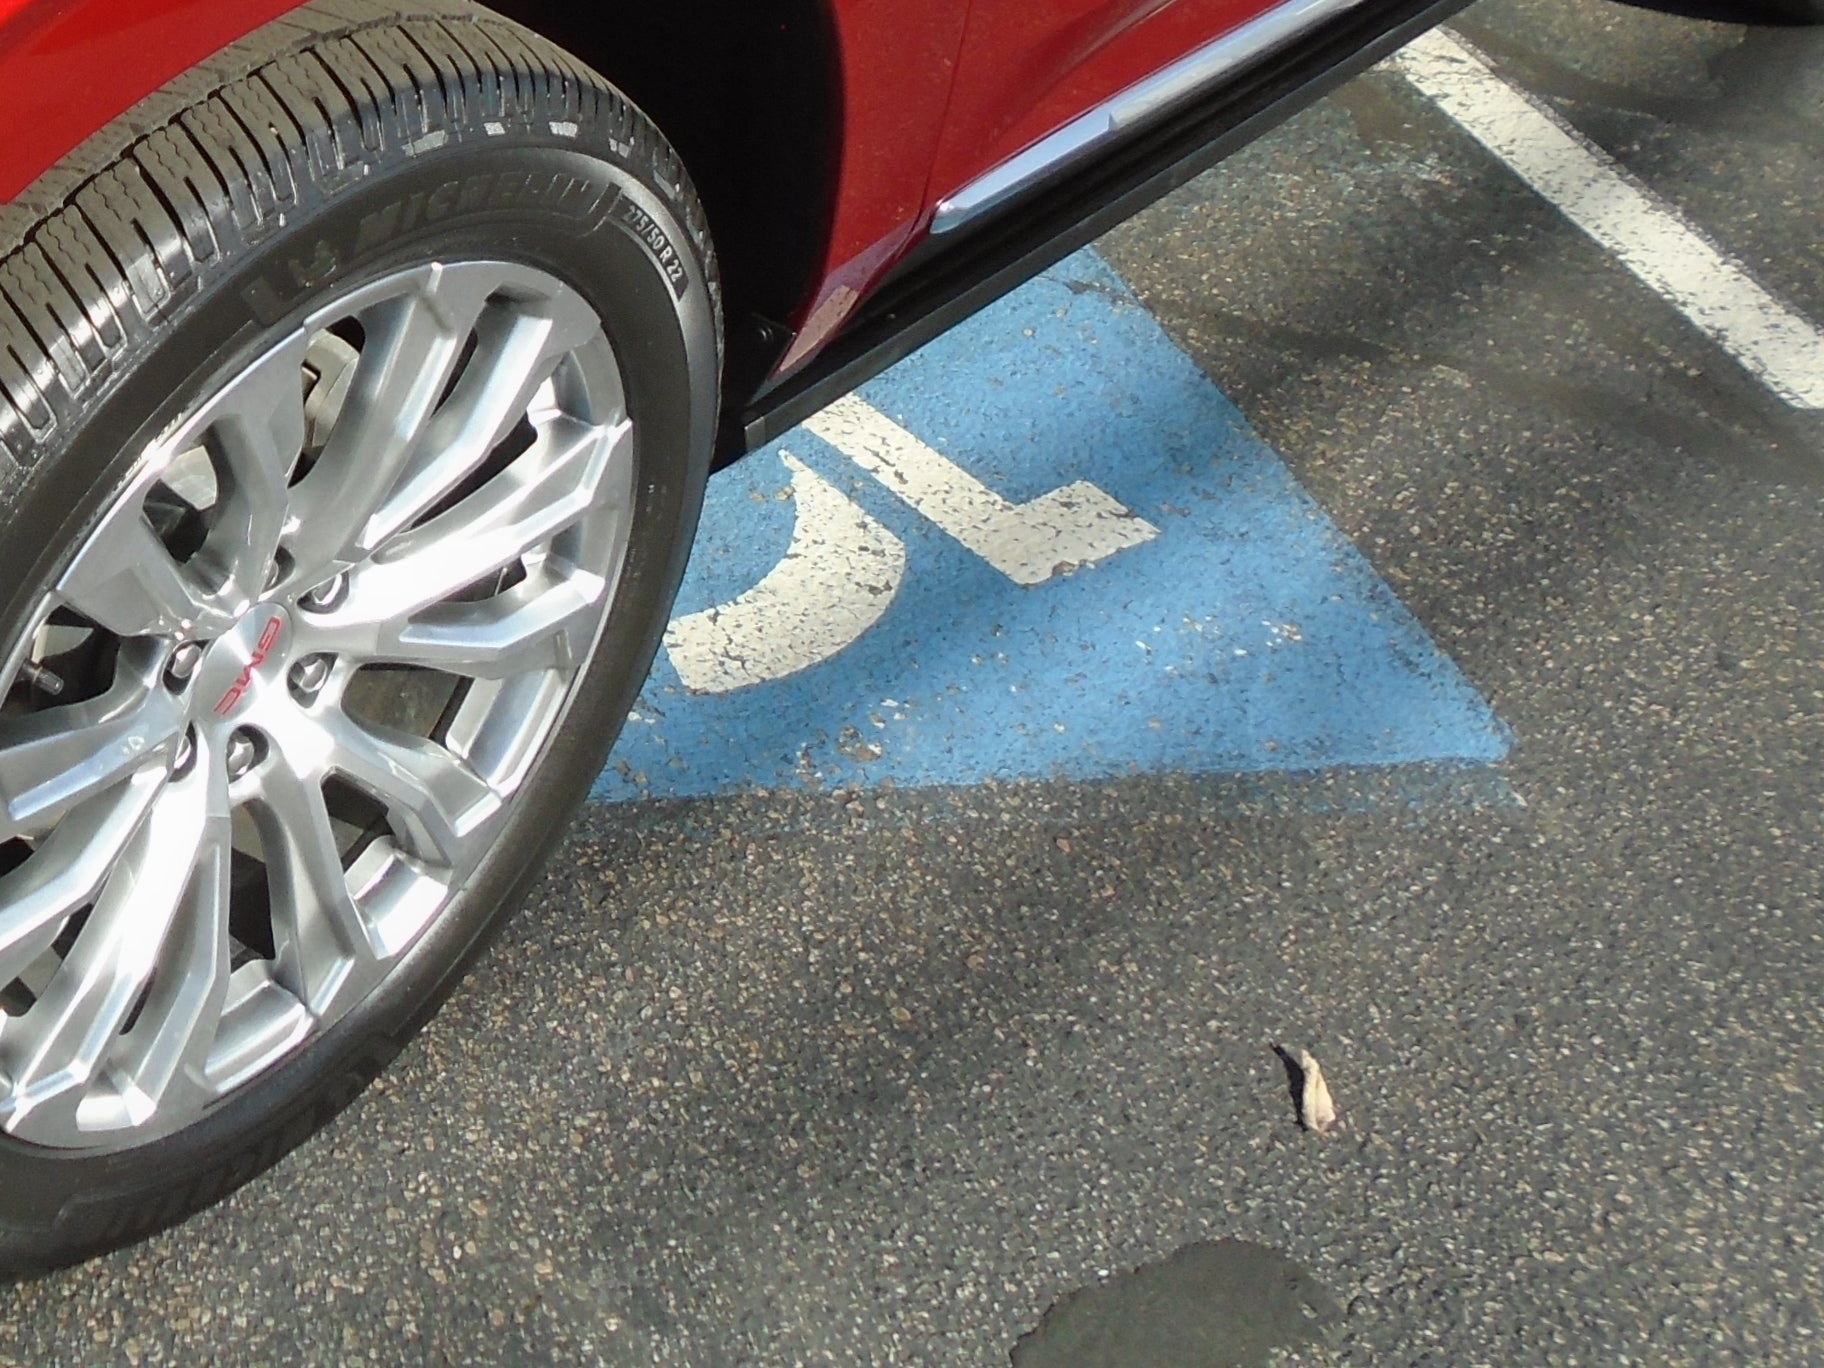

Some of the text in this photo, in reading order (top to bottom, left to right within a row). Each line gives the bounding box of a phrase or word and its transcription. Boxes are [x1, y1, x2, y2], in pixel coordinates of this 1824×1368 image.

[623, 205, 683, 283] 275/50 R 22
[212, 615, 282, 716] GMC
